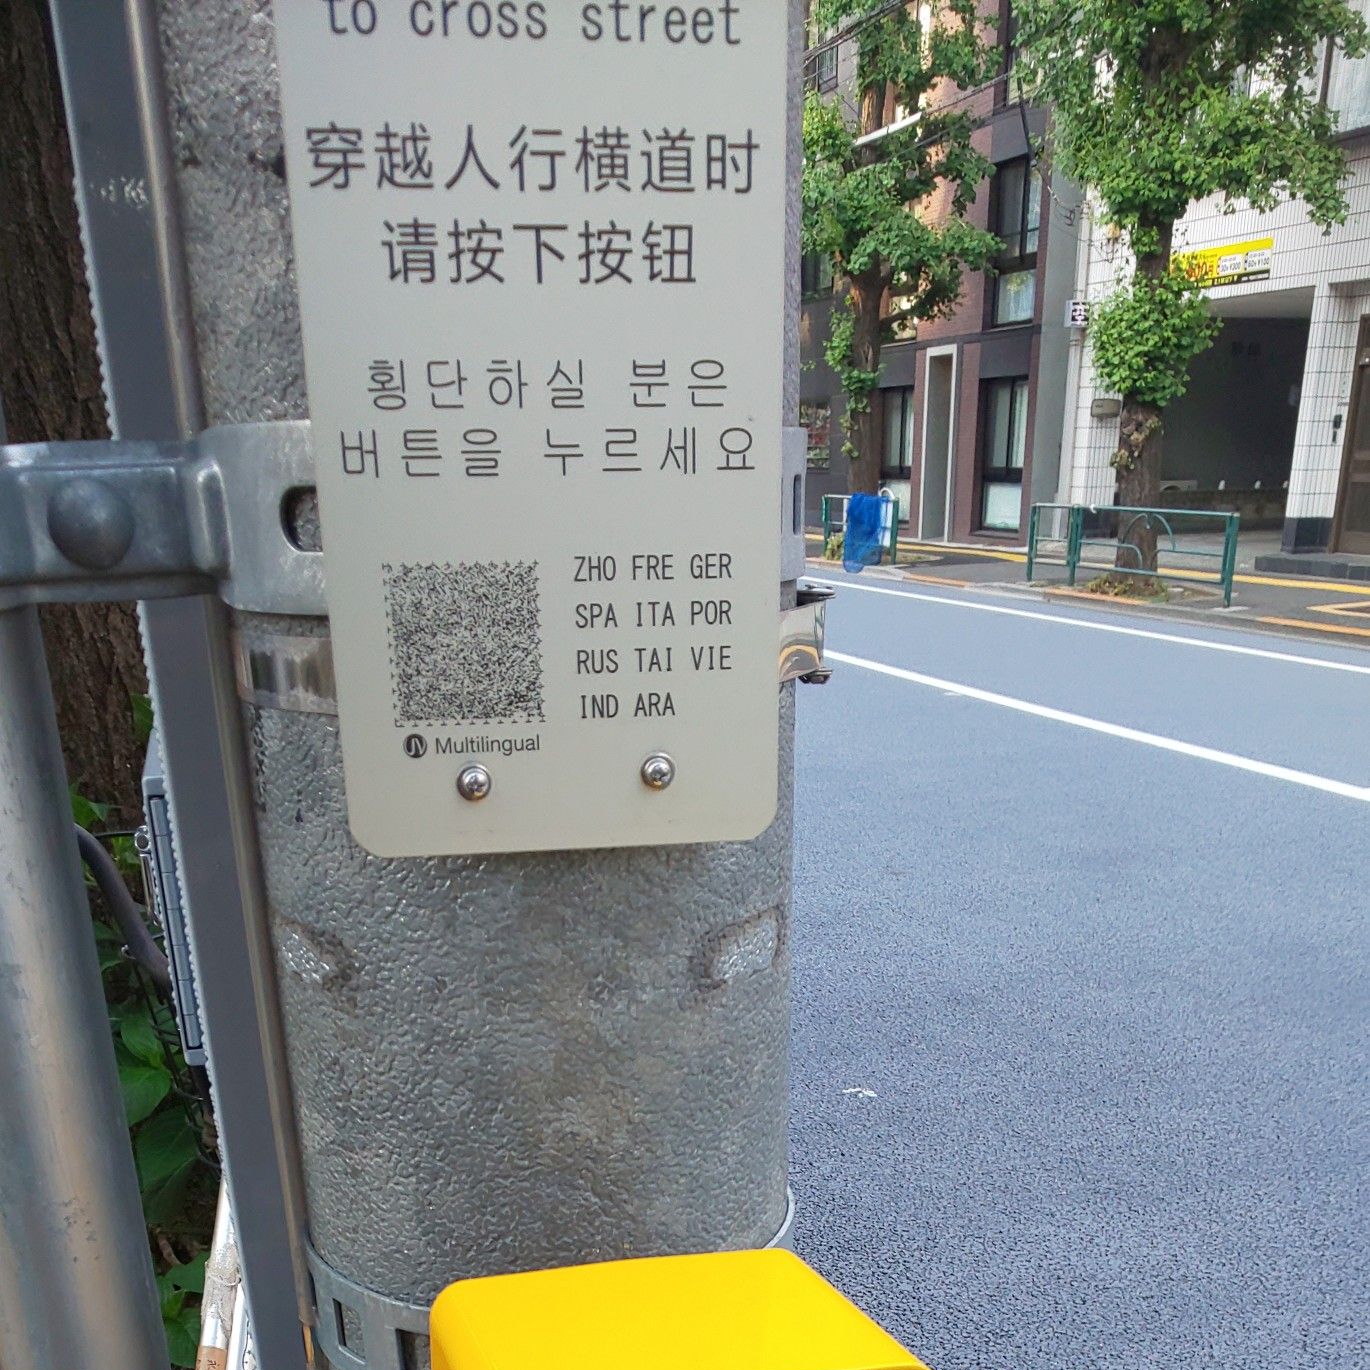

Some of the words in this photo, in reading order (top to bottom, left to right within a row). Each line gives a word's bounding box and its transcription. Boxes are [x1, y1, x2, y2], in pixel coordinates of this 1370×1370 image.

[322, 0, 378, 35] to
[408, 0, 548, 41] cross
[581, 0, 741, 46] street
[305, 121, 761, 195] 穿越人行横道时
[380, 216, 697, 285] 请按下按钮
[366, 358, 585, 411] 횡단하실
[629, 358, 728, 408] 분은
[339, 427, 502, 479] 버튼을
[543, 426, 756, 477] 누르세요
[573, 555, 617, 583] ZHO
[631, 553, 675, 581] FRE
[689, 552, 733, 580] GER
[575, 602, 619, 629] SPA
[635, 600, 676, 628] ITA
[690, 599, 732, 626] POR
[576, 648, 619, 675] RUS
[633, 646, 673, 673] TAI
[690, 645, 733, 671] VIE
[580, 693, 619, 720] IND
[633, 691, 676, 718] ARA
[435, 733, 540, 757] Multilingual
